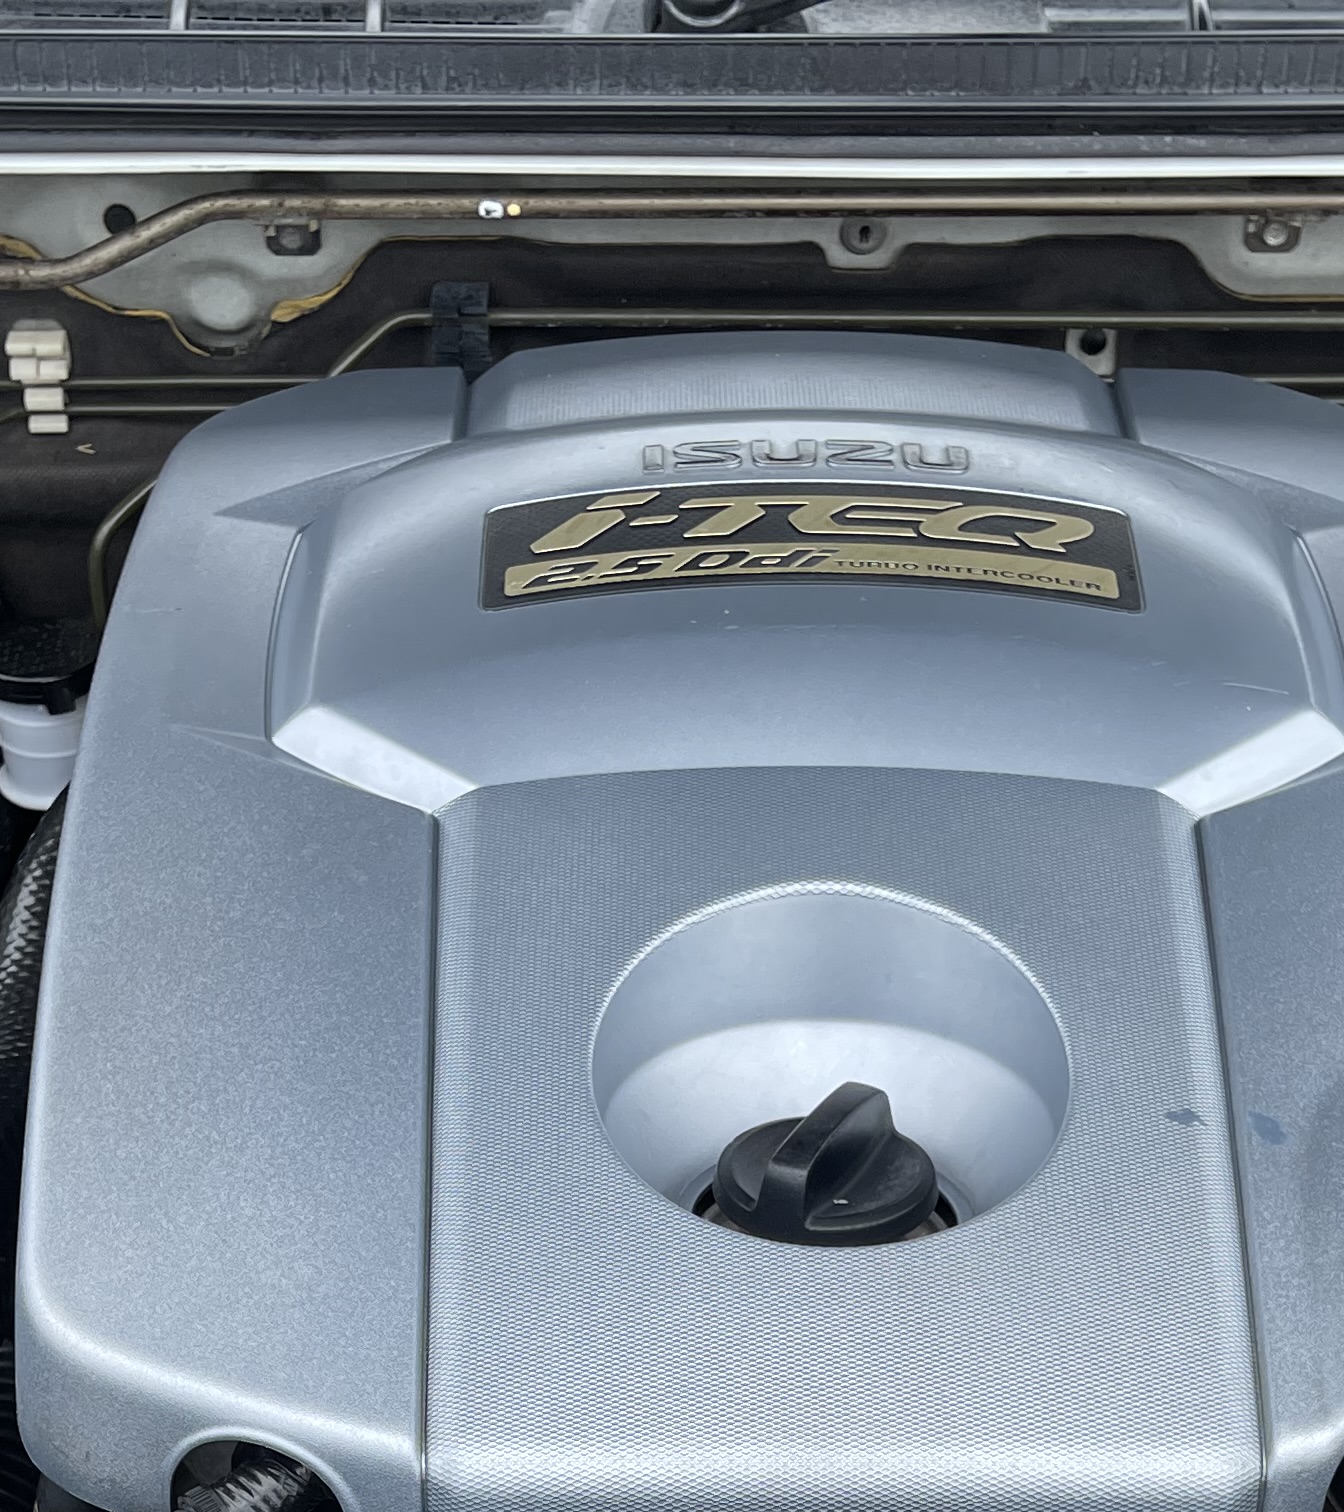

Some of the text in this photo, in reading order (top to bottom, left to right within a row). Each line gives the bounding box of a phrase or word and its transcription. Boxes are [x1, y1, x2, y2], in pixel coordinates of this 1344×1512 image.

[642, 438, 972, 474] ISUZU
[833, 559, 920, 571] TURBO
[927, 563, 1103, 592] INTERCOOLER
